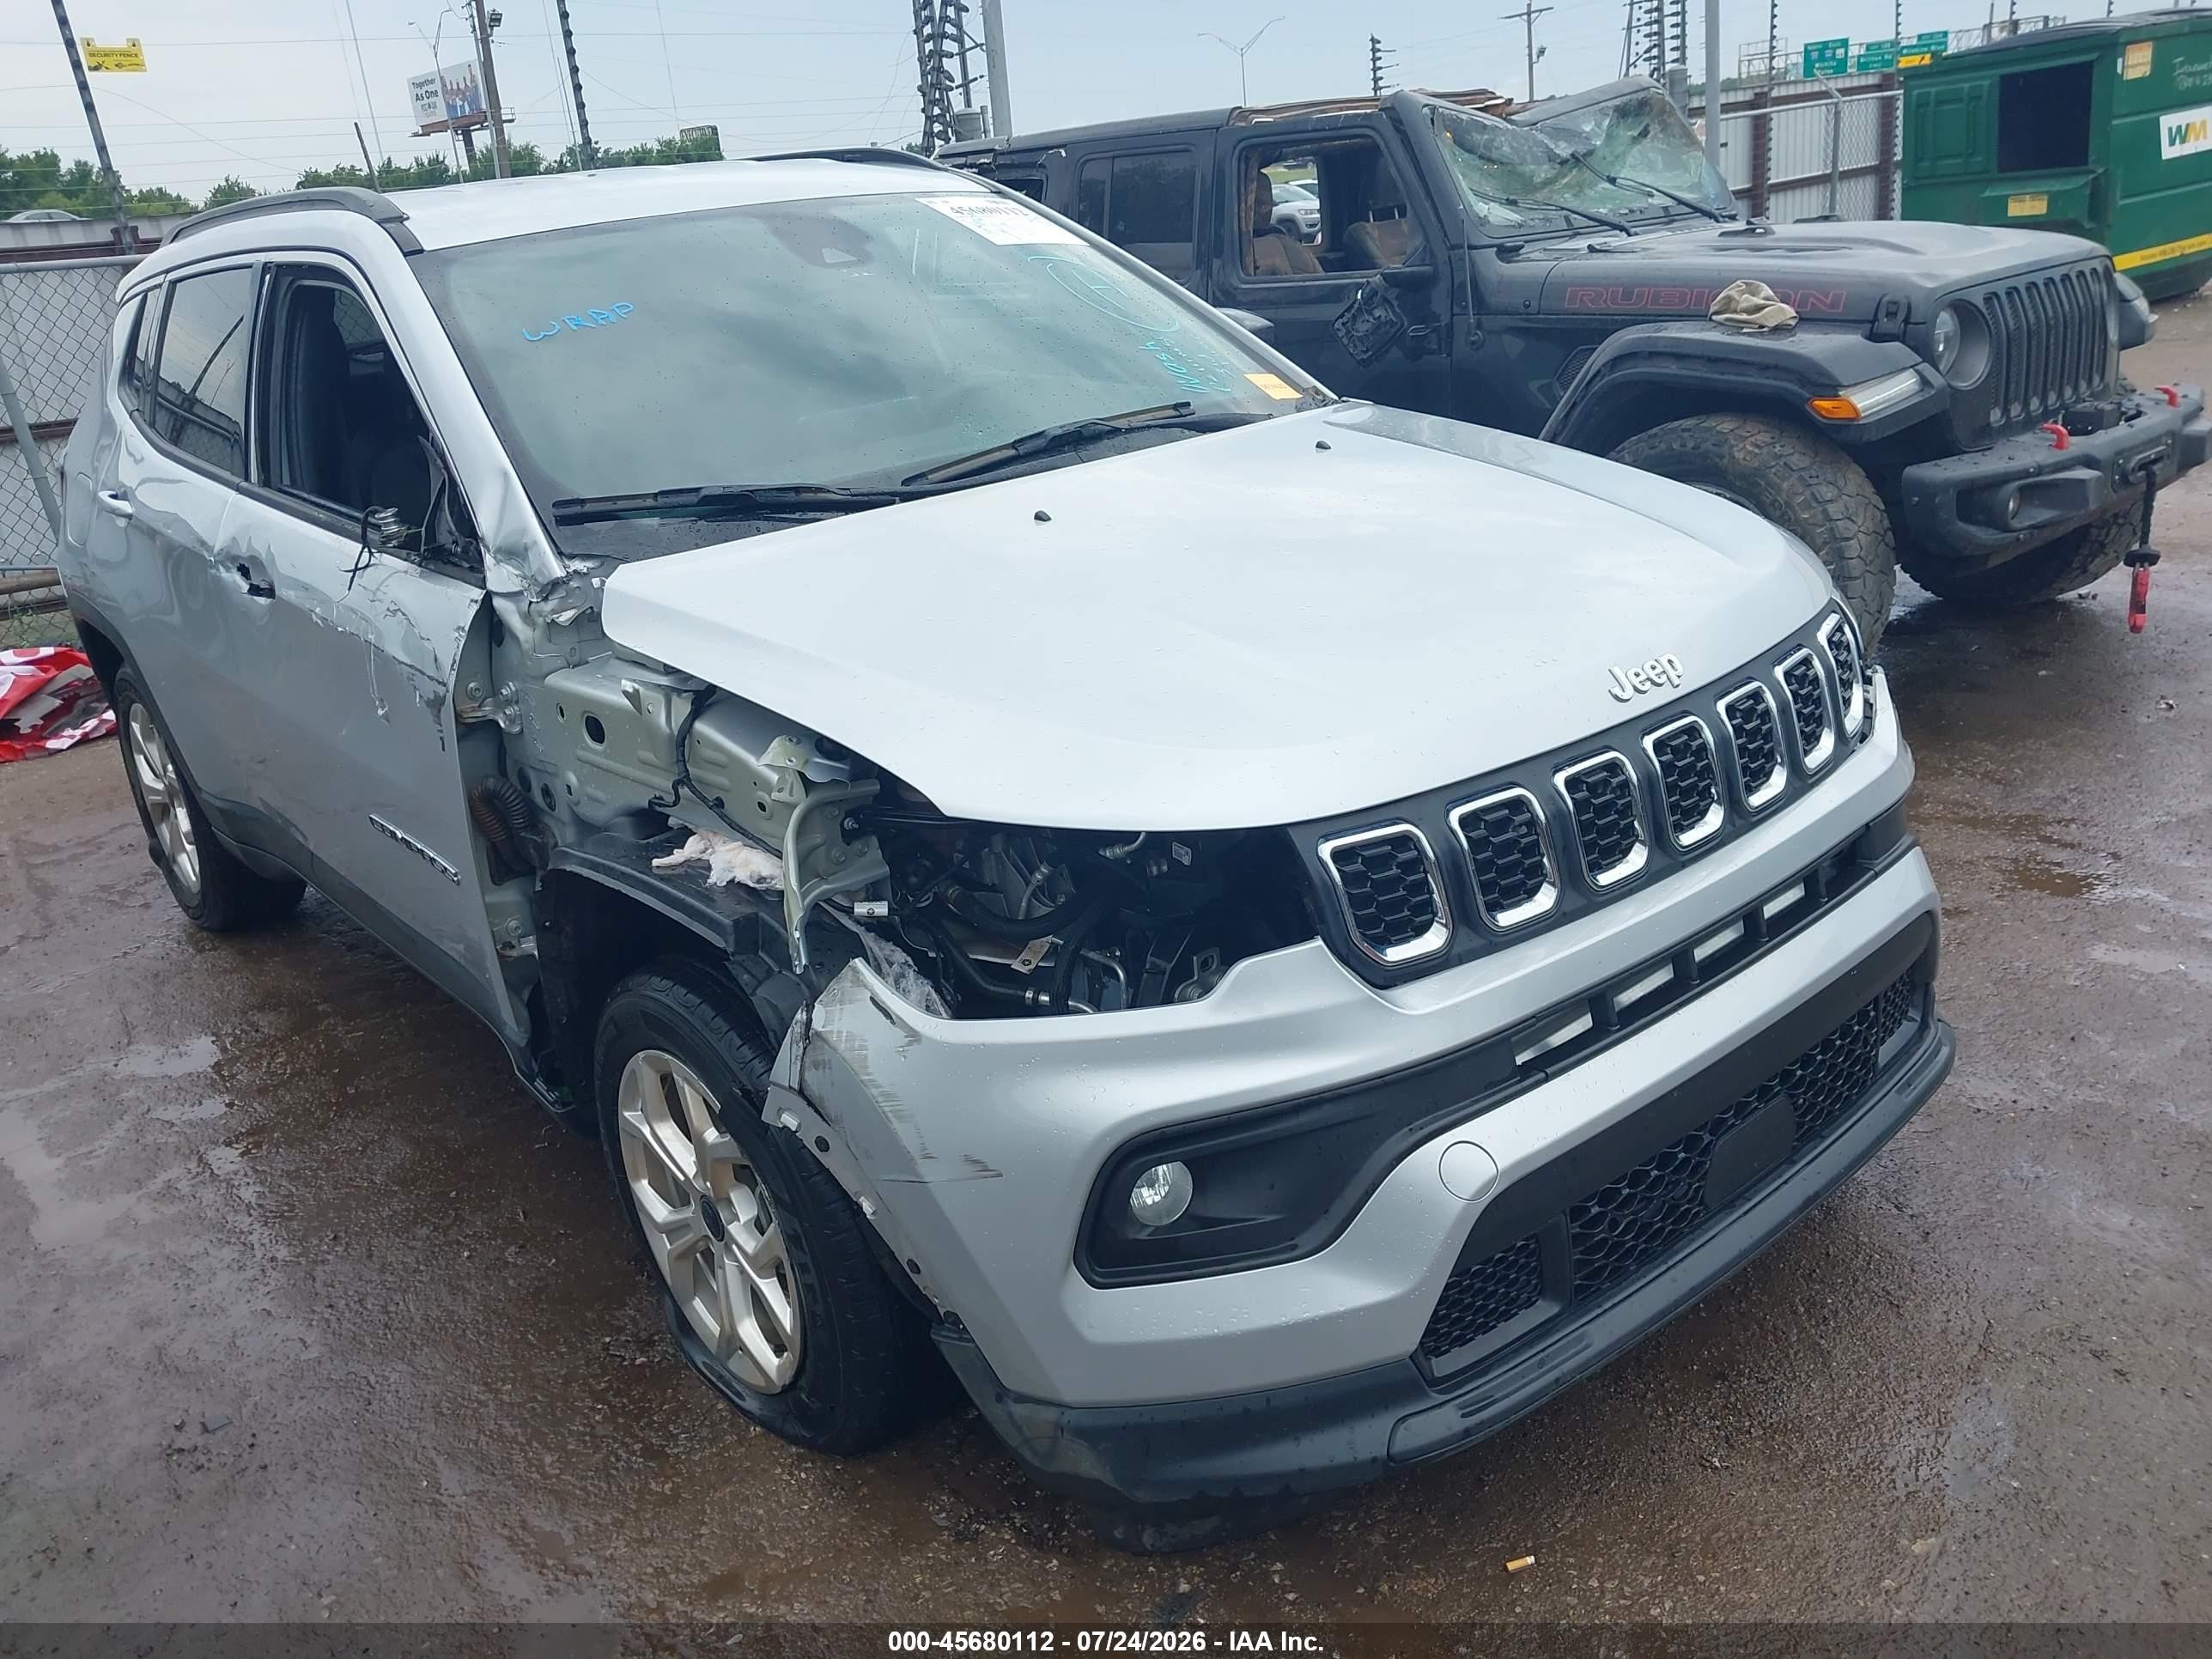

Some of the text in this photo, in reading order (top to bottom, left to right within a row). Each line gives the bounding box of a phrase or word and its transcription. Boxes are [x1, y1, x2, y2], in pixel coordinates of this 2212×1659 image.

[412, 78, 436, 90] Together
[415, 88, 440, 102] As One
[2167, 119, 2209, 147] WM
[522, 302, 634, 341] WRAP
[1607, 653, 1683, 703] Jeep
